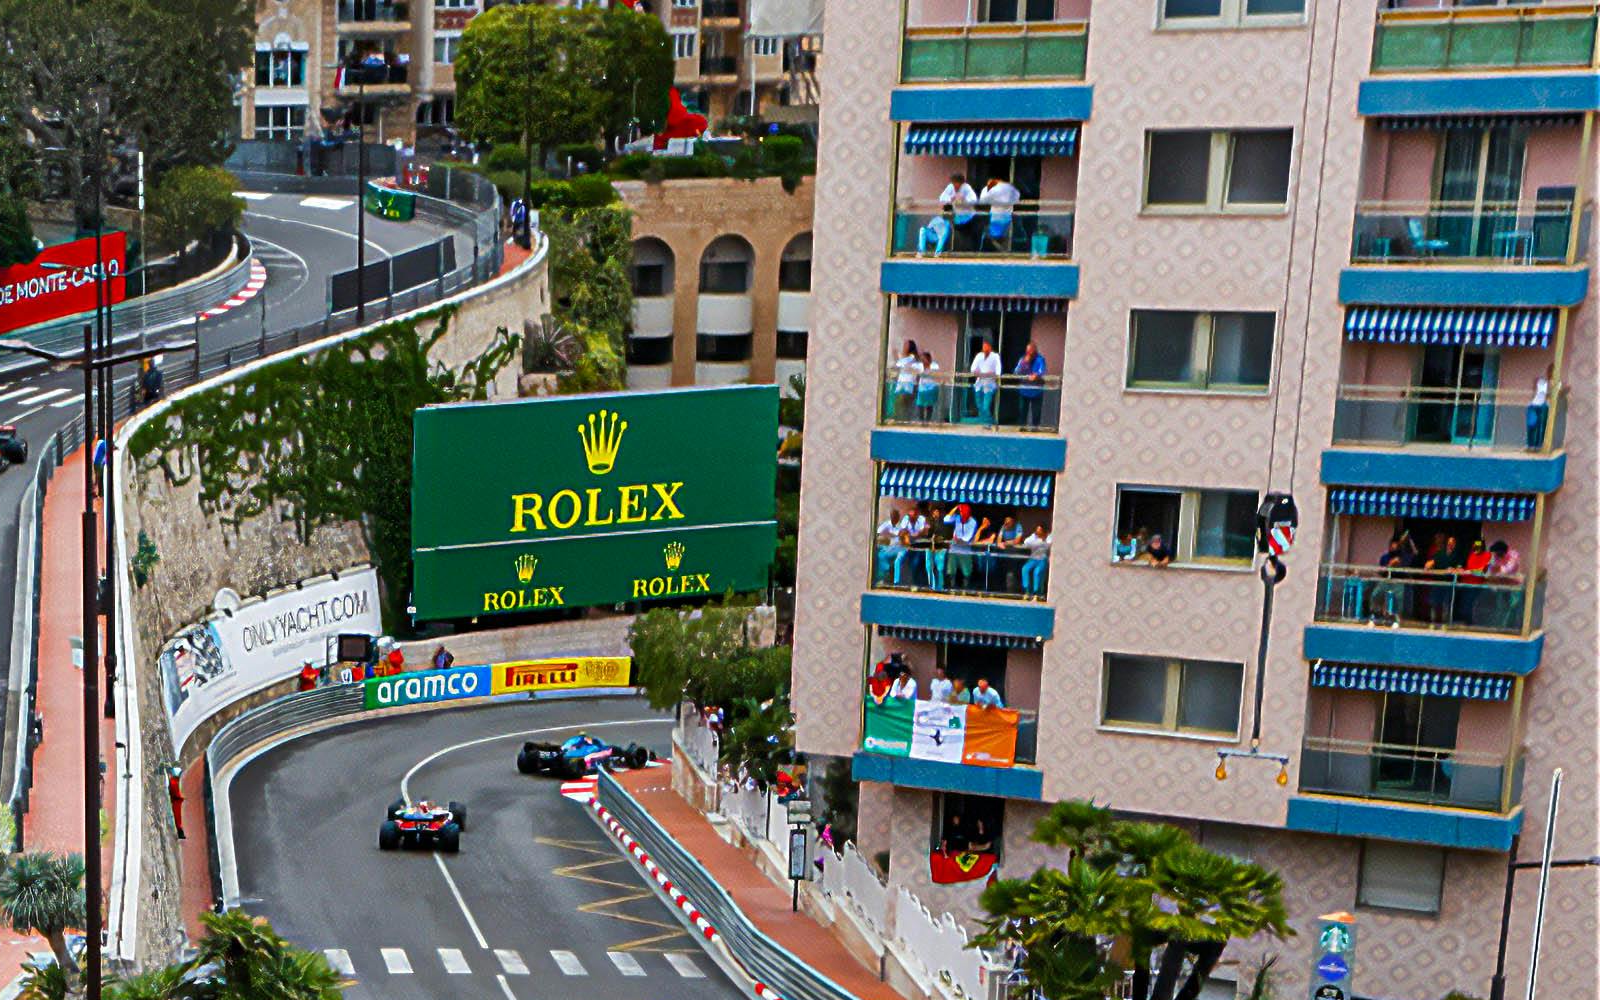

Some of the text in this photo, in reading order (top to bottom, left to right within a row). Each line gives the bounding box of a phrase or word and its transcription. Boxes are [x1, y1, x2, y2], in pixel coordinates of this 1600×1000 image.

[509, 481, 686, 533] ROLEX
[482, 585, 566, 612] ROLEX
[632, 572, 712, 599] ROLEX
[376, 671, 478, 704] aramco
